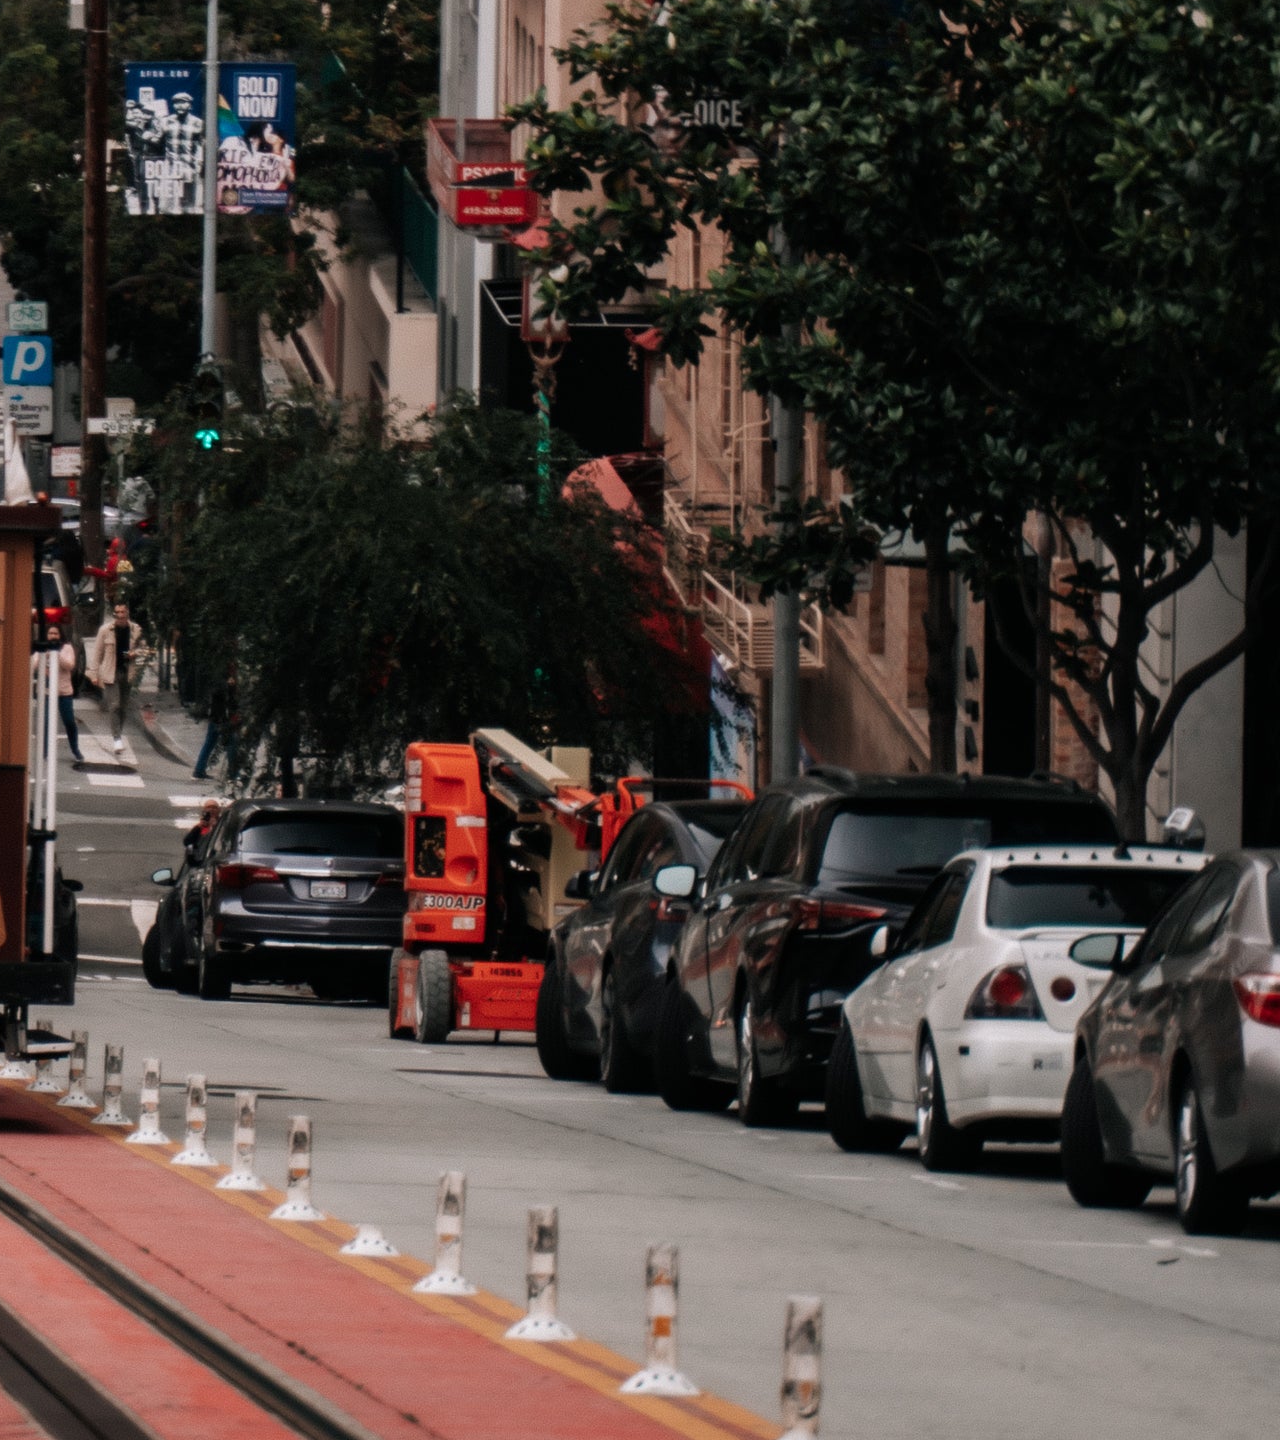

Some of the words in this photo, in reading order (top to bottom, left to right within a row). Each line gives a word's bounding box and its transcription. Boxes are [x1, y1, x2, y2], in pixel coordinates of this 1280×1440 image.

[238, 76, 279, 96] BOLD
[237, 97, 278, 118] NOW
[145, 159, 183, 180] BOLD
[462, 166, 527, 182] PSYCIC
[145, 178, 185, 199] THEN
[20, 403, 50, 413] Mary's
[14, 421, 41, 429] arage
